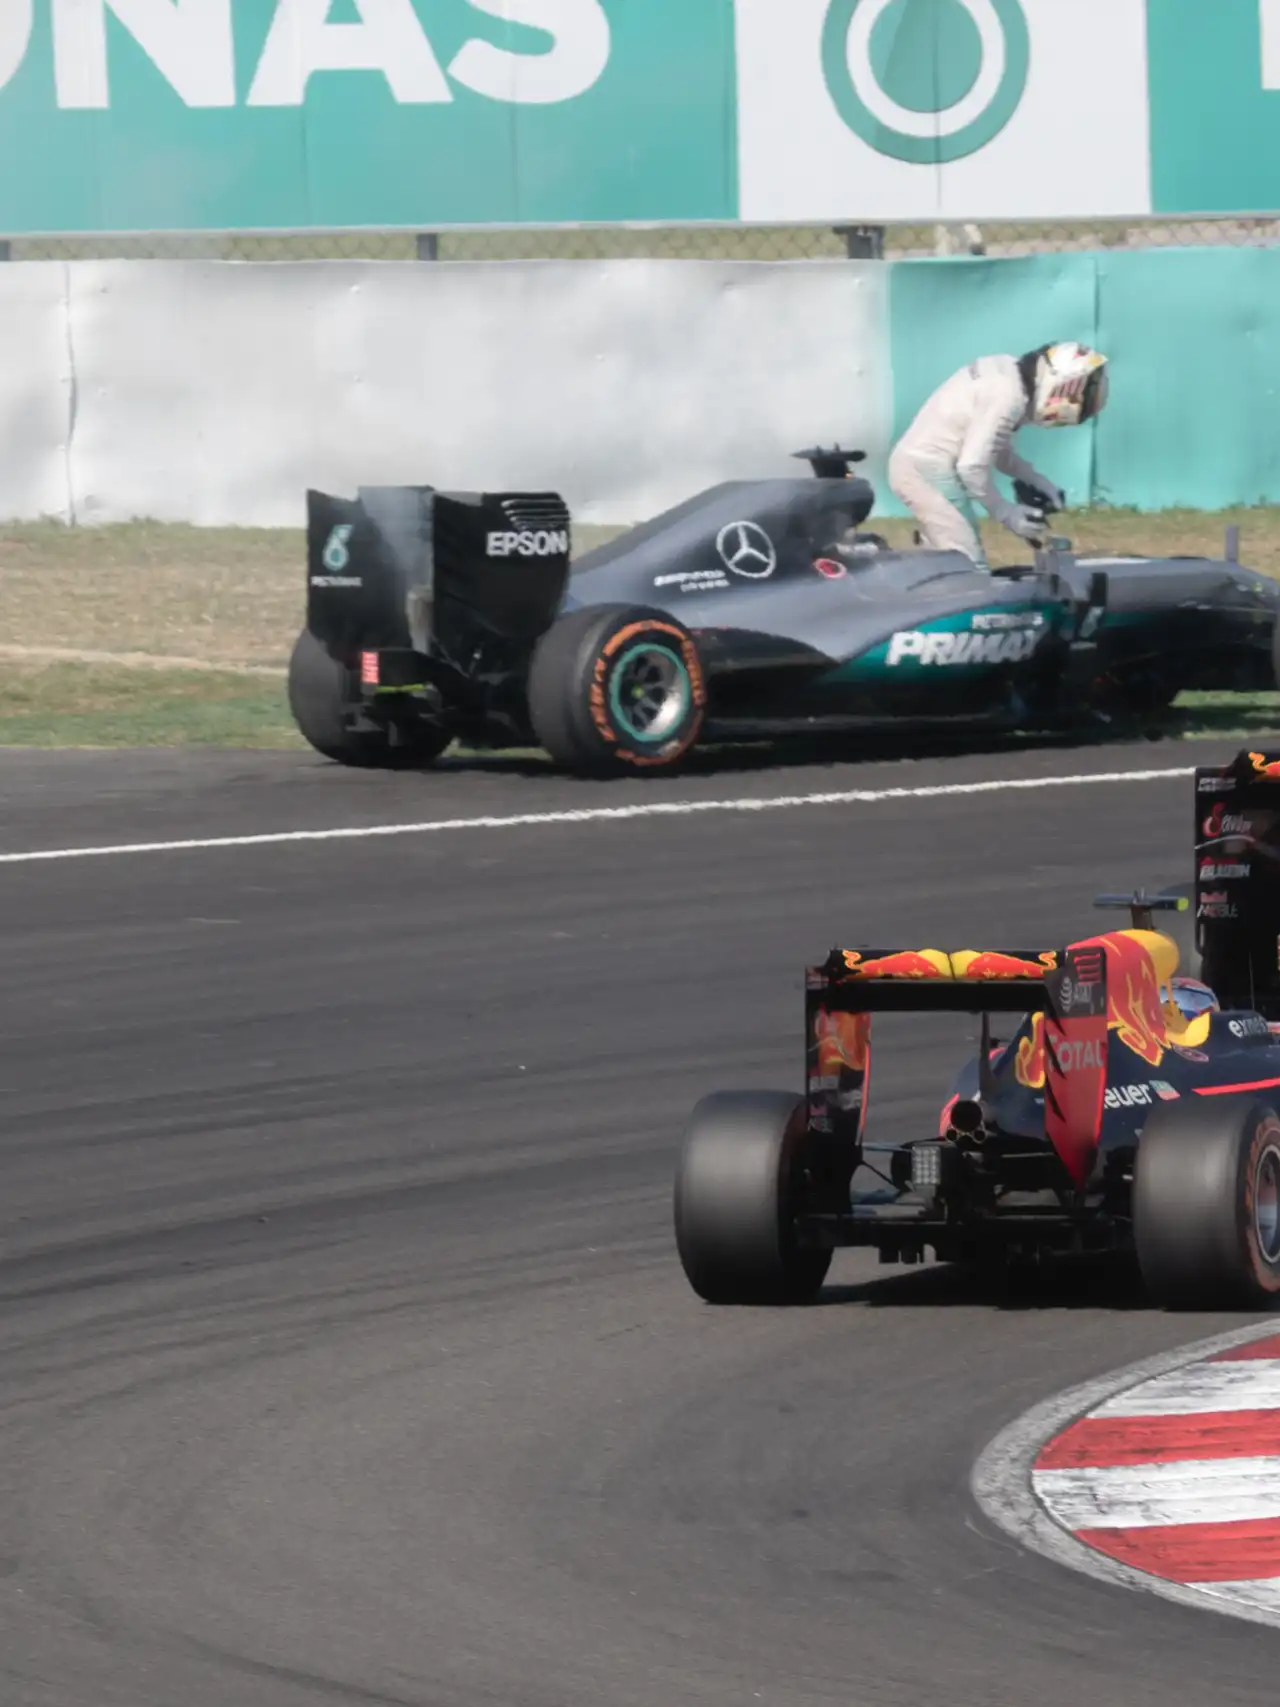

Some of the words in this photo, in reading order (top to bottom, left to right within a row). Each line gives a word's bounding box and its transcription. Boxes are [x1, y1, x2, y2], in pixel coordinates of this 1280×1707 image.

[0, 0, 611, 109] NAS
[486, 531, 568, 557] EPSON
[1103, 1083, 1153, 1109] euer
